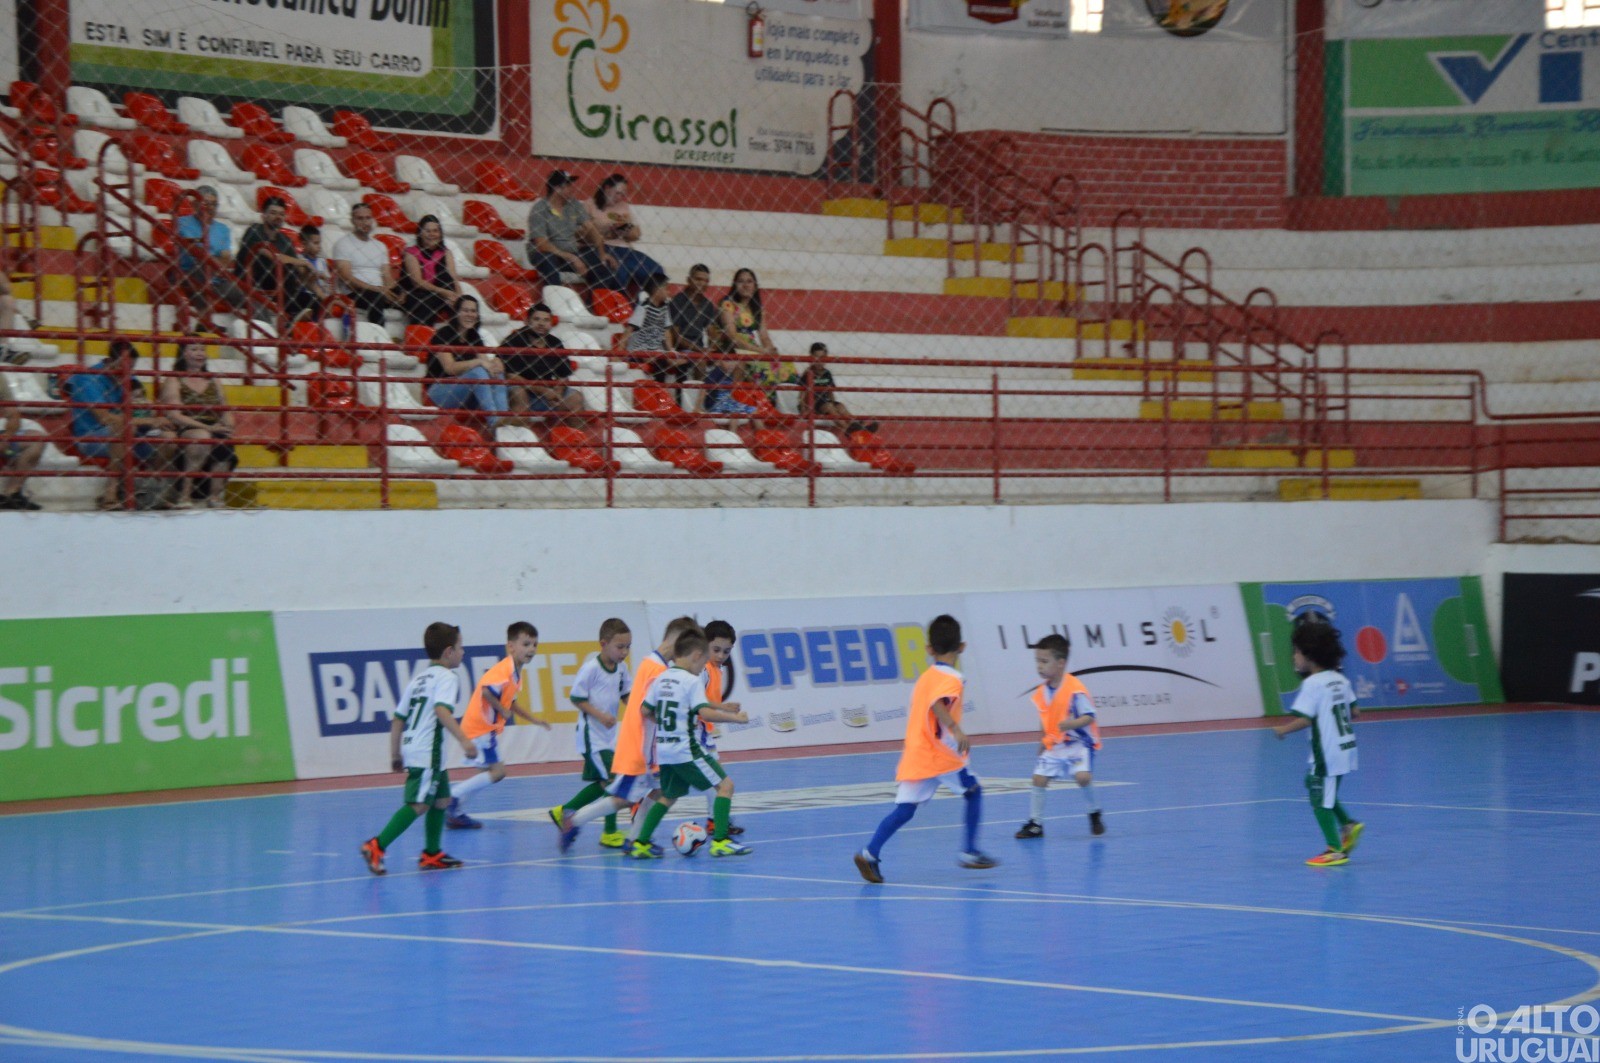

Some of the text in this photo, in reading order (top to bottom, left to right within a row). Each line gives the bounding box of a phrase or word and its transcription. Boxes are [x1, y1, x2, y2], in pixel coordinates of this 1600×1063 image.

[85, 21, 129, 43] ESTA
[143, 28, 172, 48] SIM
[285, 43, 326, 65] PARA
[334, 50, 362, 67] SEU
[370, 52, 422, 73] CARRO
[568, 38, 737, 148] Girassol
[673, 148, 736, 165] presentes
[0, 658, 250, 750] Sicredi
[655, 699, 679, 732] 15
